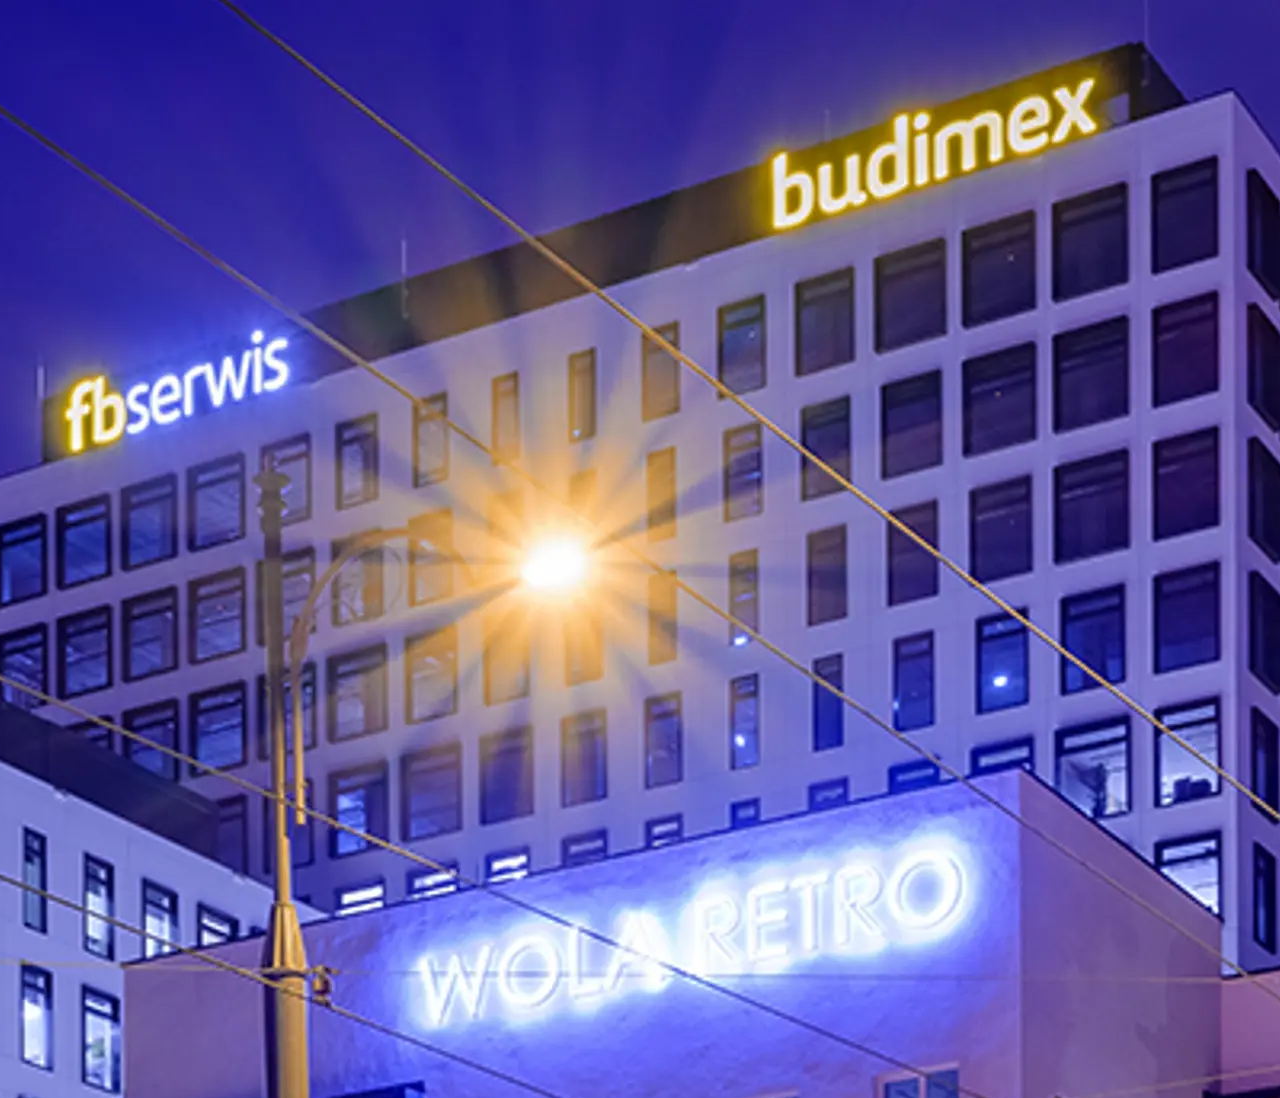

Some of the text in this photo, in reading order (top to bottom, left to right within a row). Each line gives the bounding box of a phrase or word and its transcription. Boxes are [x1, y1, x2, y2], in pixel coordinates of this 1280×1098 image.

[771, 78, 1097, 230] budimex
[65, 329, 289, 452] fbserwis
[418, 845, 965, 1028] WOLA RETRO
